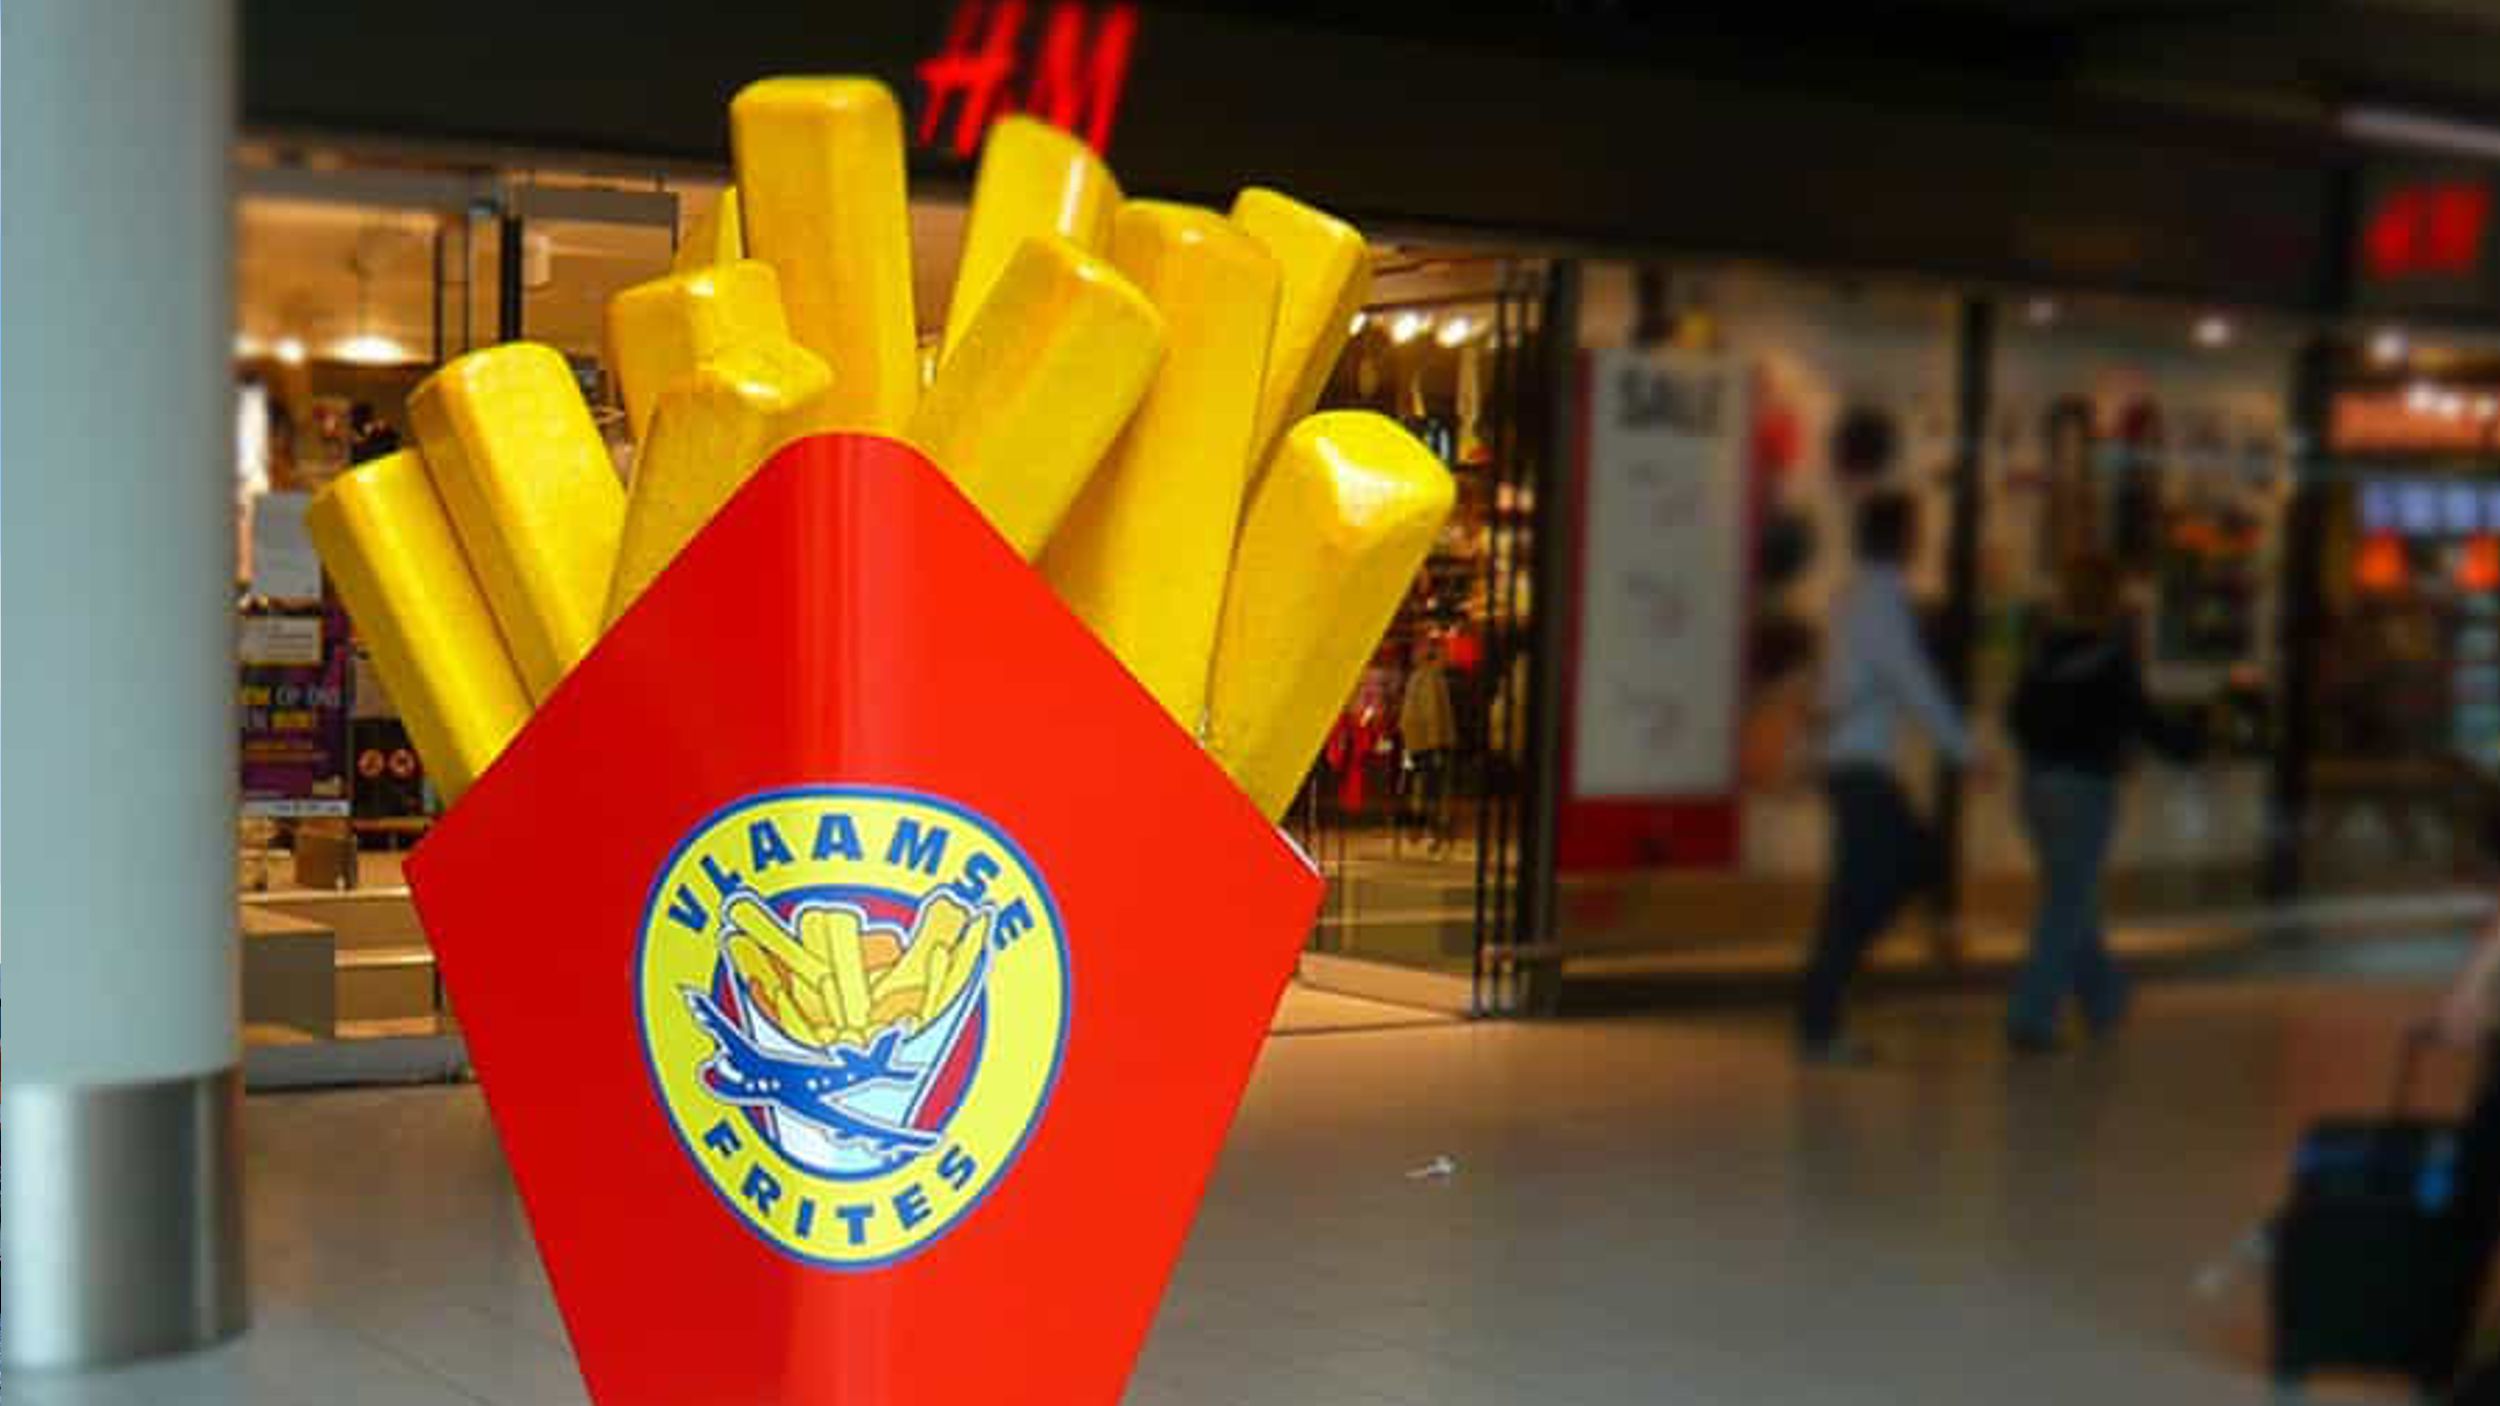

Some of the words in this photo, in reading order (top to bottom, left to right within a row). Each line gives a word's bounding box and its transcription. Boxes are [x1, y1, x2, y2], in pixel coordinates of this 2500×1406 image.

[916, 0, 1136, 158] HM
[667, 813, 1035, 950] VLAAMSE
[702, 1119, 978, 1246] FRITES
